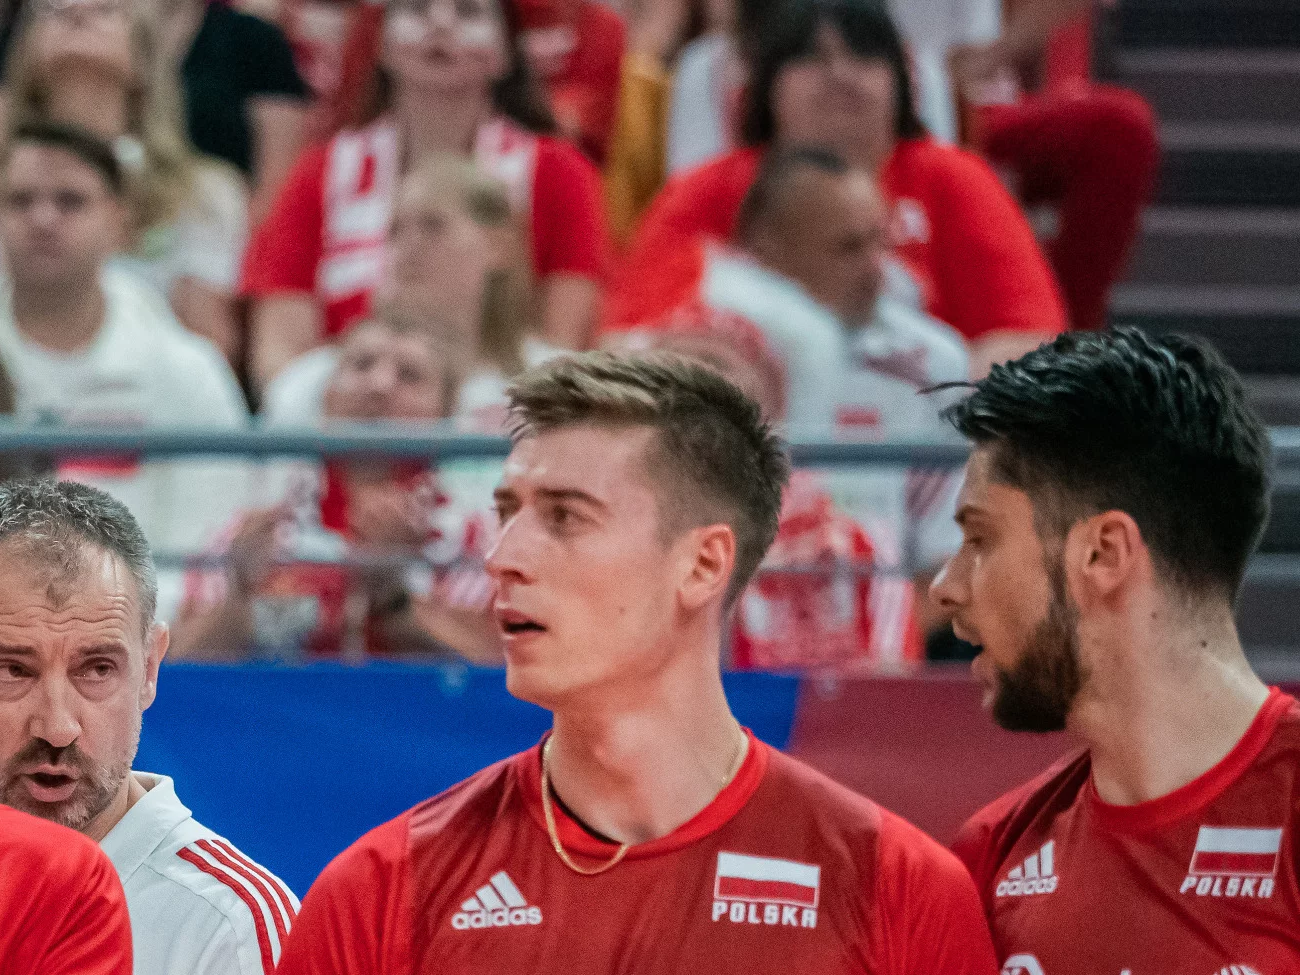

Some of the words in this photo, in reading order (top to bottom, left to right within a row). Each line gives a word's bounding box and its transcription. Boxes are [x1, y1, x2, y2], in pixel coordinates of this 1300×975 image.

[996, 876, 1059, 897] adidas
[1179, 876, 1275, 898] POLSKA
[451, 906, 543, 930] adidas
[712, 901, 818, 928] POLSKA
